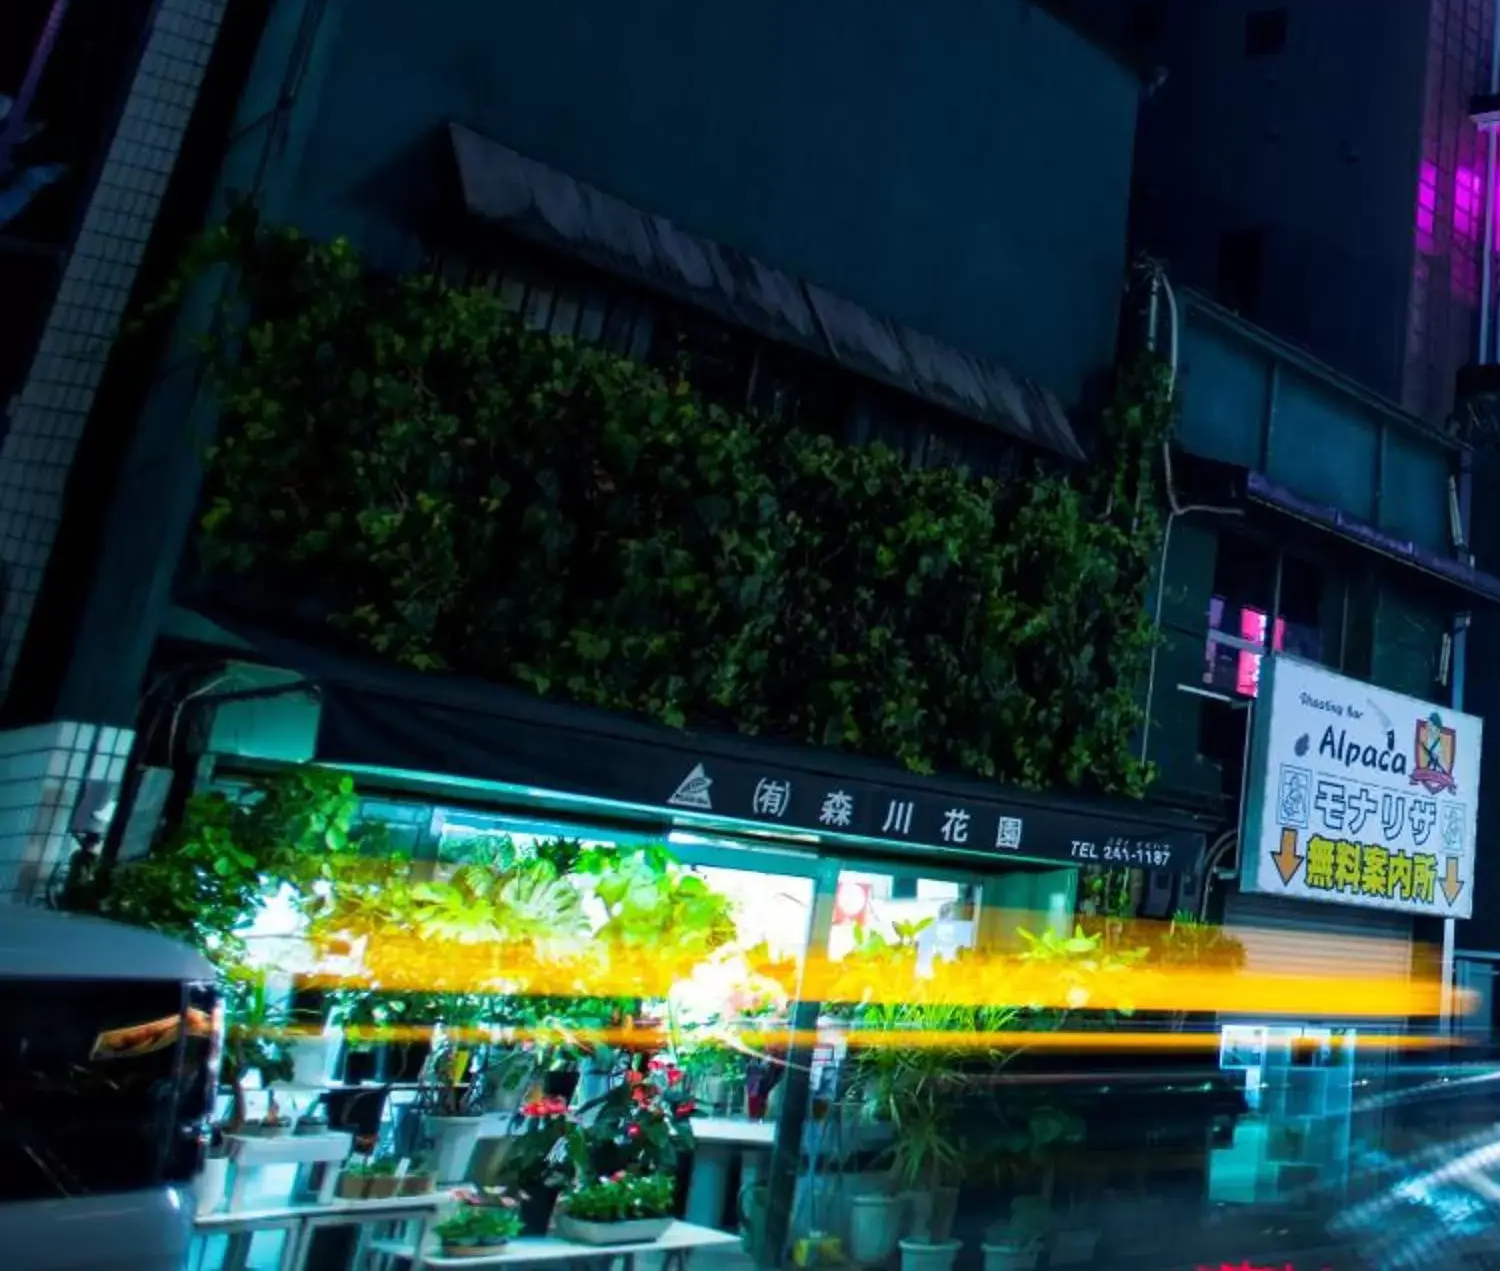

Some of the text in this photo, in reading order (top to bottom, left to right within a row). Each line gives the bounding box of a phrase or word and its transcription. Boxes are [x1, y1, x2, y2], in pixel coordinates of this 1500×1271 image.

[1319, 724, 1407, 776] Alpaca
[1314, 780, 1437, 846] モナリザ
[1071, 841, 1098, 859] TEL
[1305, 833, 1439, 905] 無料案内所
